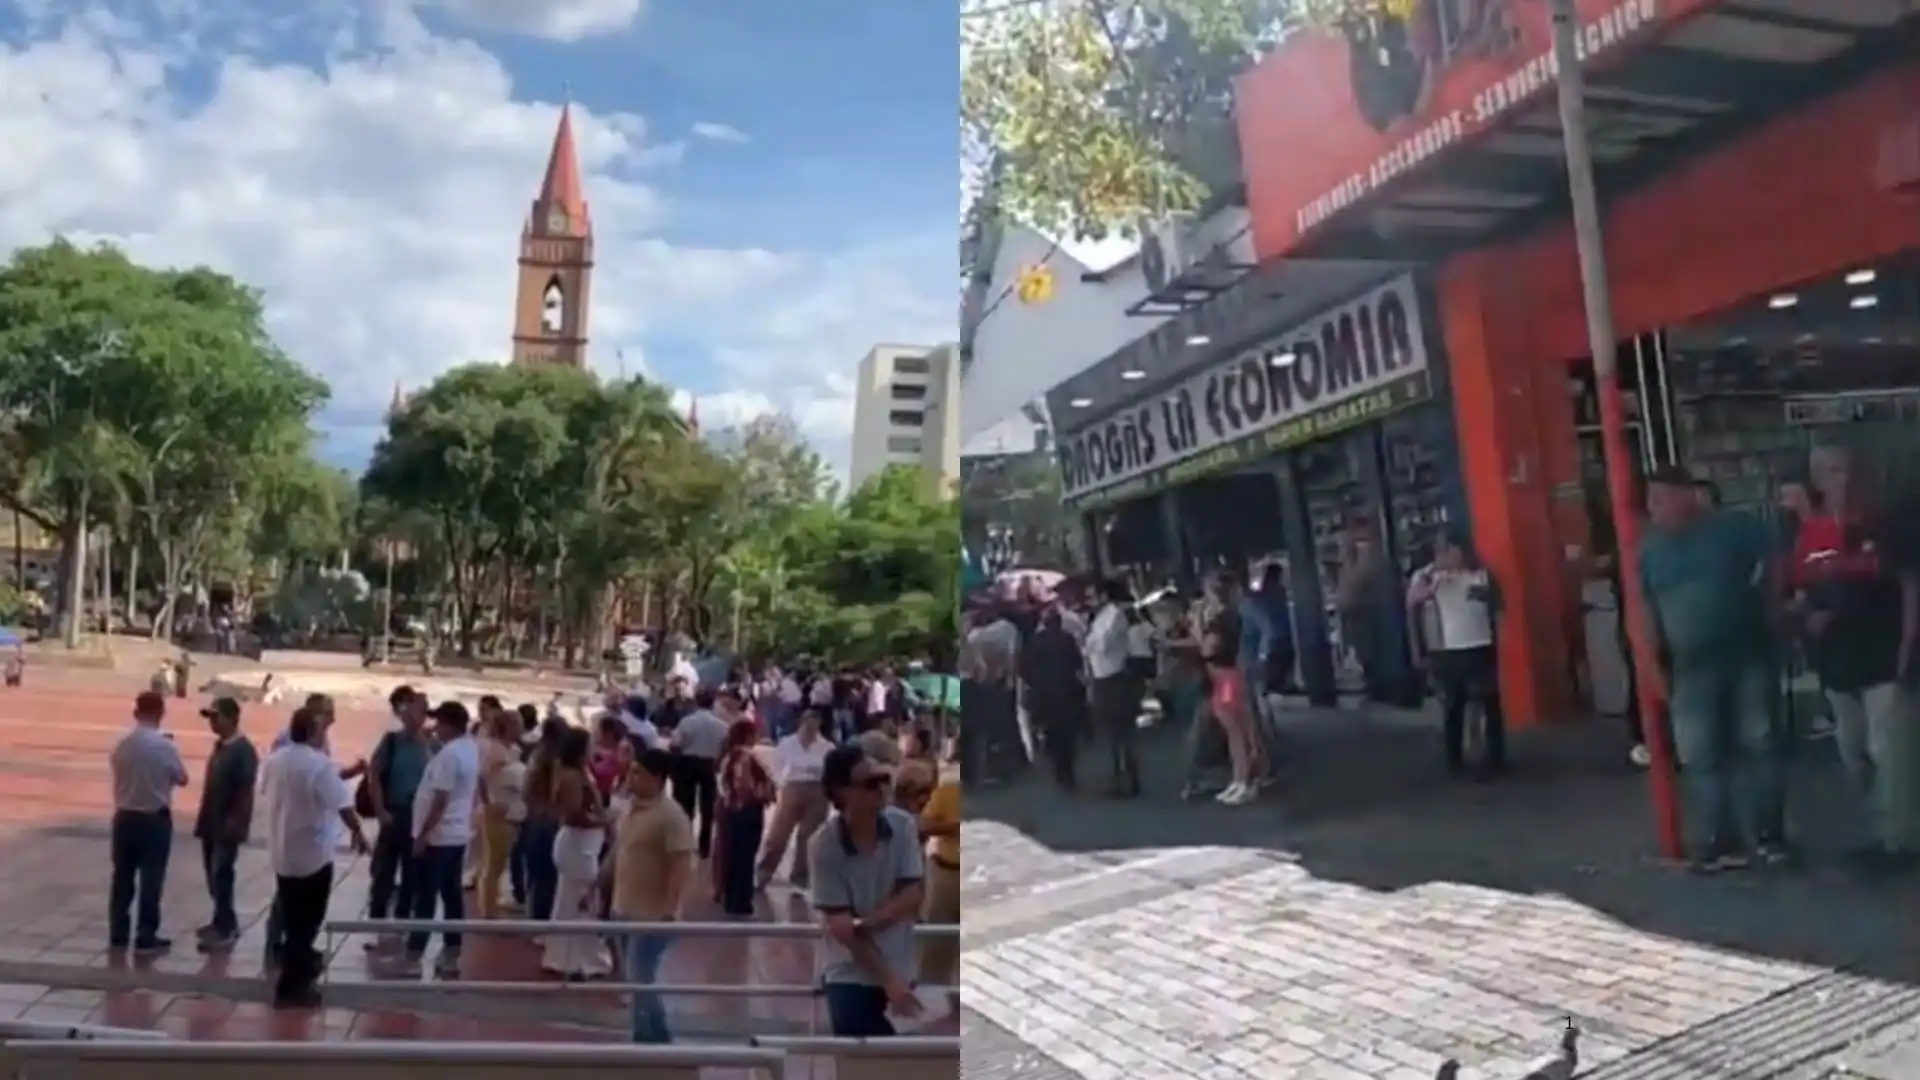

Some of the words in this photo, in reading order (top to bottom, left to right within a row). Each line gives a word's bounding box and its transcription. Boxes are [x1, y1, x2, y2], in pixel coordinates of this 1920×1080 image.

[1061, 408, 1155, 490] DROGAS
[1161, 386, 1197, 454] LA
[1205, 290, 1413, 437] ECONOMIA
